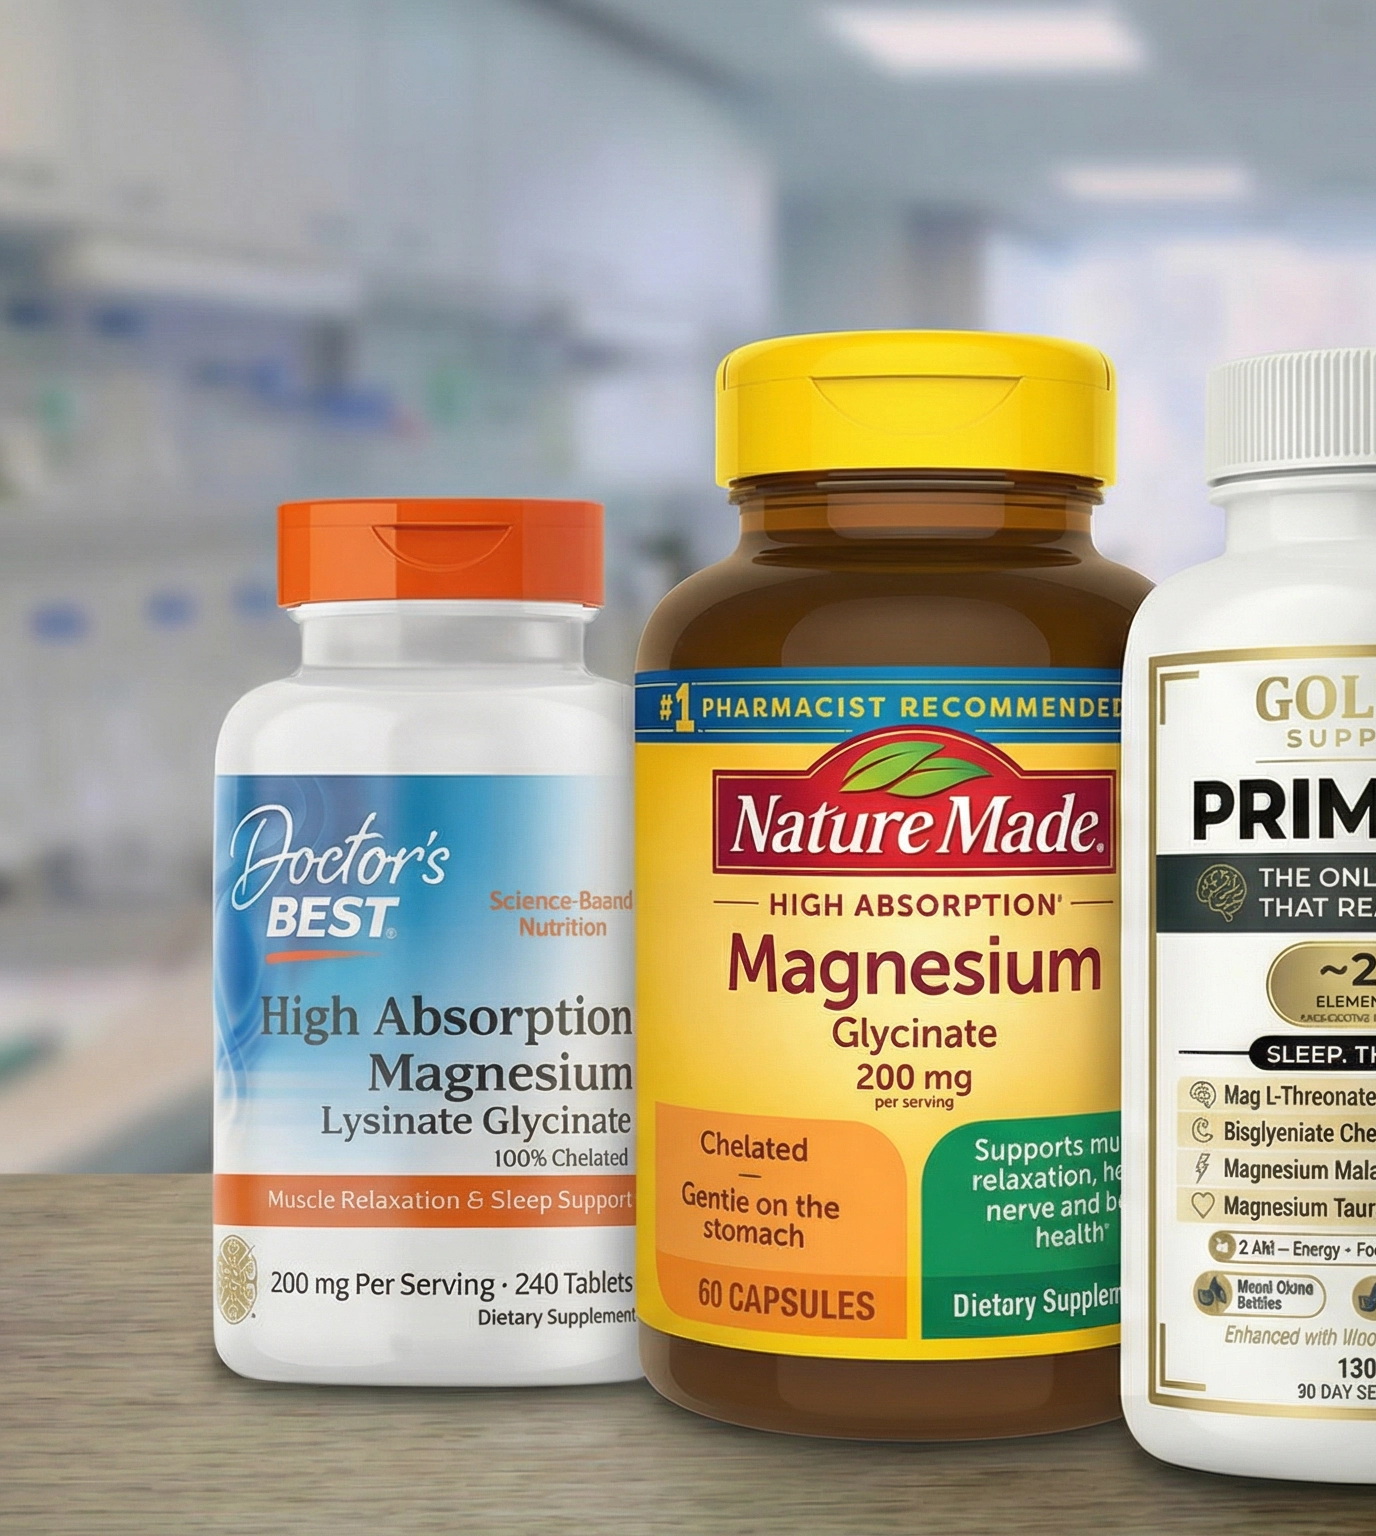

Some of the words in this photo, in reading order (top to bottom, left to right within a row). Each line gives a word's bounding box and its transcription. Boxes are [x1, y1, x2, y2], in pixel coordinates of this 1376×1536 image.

[659, 683, 695, 733] #1
[702, 697, 885, 718] PHARMACIST
[730, 795, 931, 854] Nature
[231, 804, 451, 911] Doctor's
[1259, 868, 1311, 888] THE
[770, 894, 843, 916] HIGH
[1259, 898, 1329, 918] THAT
[519, 917, 607, 937] Nutrition
[729, 933, 1101, 1010] Magnesium
[261, 996, 360, 1045] High
[374, 995, 633, 1045] Absorption
[832, 1017, 997, 1056] Glycinate
[1267, 1046, 1347, 1063] SLEEP.
[369, 1053, 632, 1102] Magnesium
[856, 1064, 914, 1090] 200
[924, 1069, 972, 1097] mg
[875, 1097, 898, 1110] per
[903, 1096, 954, 1111] serving
[1225, 1085, 1260, 1110] Mag
[1267, 1086, 1376, 1106] L-Threonate
[321, 1106, 473, 1142] Lysinate
[483, 1106, 631, 1142] Glycinate
[495, 1149, 547, 1168] 100%
[552, 1148, 628, 1167] Chelated
[700, 1130, 808, 1162] Chelated
[974, 1135, 1083, 1165] Supports
[972, 1165, 1097, 1191] relaxation,
[1225, 1158, 1328, 1183] Magnesium
[268, 1190, 335, 1209] Muscle
[342, 1190, 459, 1210] Relaxation
[468, 1190, 483, 1209] &
[491, 1190, 552, 1214] Sleep
[559, 1190, 632, 1214] Support
[756, 1197, 787, 1217] on
[796, 1194, 840, 1220] the
[986, 1200, 1054, 1221] nerve
[1061, 1193, 1099, 1217] and
[1225, 1196, 1327, 1221] Magnesium
[703, 1219, 804, 1248] stomach
[1239, 1240, 1248, 1255] 2
[1293, 1241, 1340, 1260] Energy
[271, 1271, 308, 1294] 200
[315, 1276, 349, 1301] mg
[356, 1273, 395, 1295] Per
[400, 1272, 495, 1302] Serving
[515, 1272, 558, 1295] 240
[564, 1271, 633, 1294] Tablets
[699, 1278, 722, 1308] 60
[729, 1283, 875, 1321] CAPSULES
[953, 1288, 1036, 1322] Dietary
[478, 1309, 542, 1329] Dietary
[547, 1308, 636, 1329] Supplement
[1225, 1325, 1299, 1345] Enhanced
[1305, 1329, 1337, 1346] with
[1338, 1358, 1376, 1378] 130
[1322, 1385, 1352, 1400] DAY
